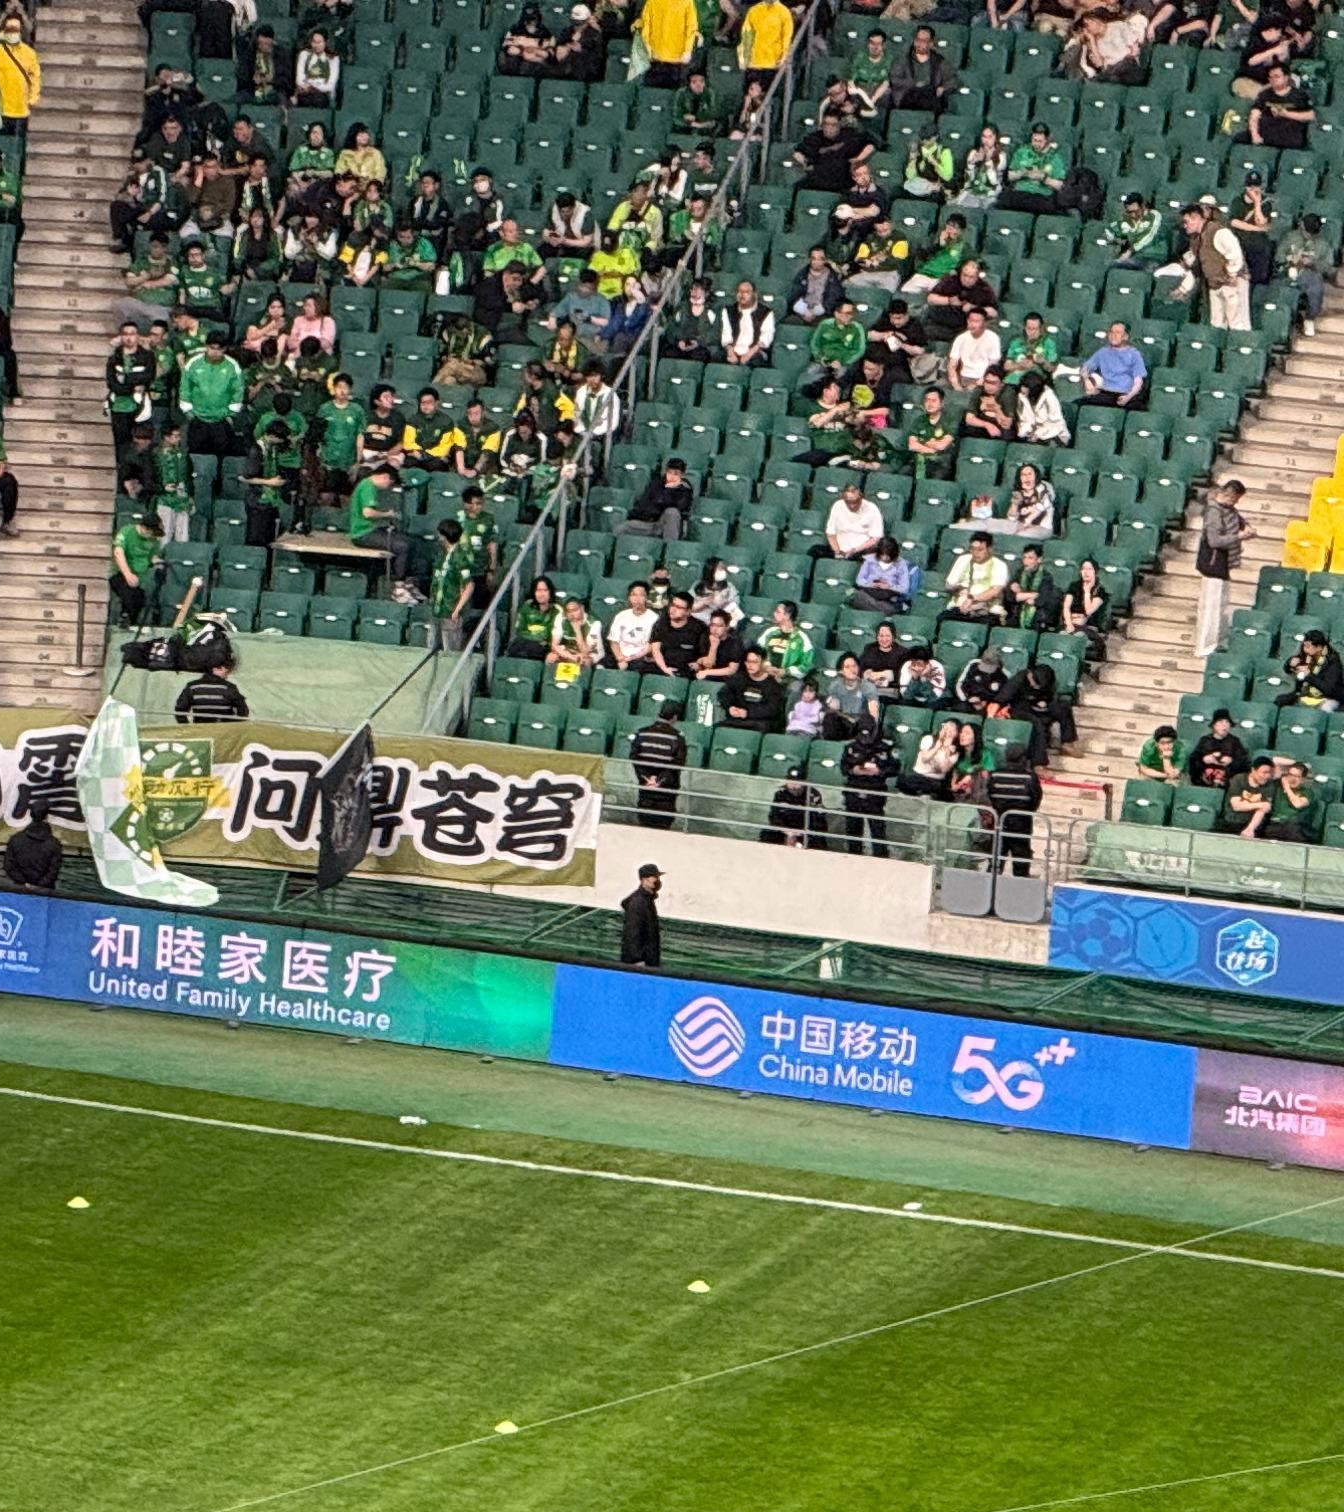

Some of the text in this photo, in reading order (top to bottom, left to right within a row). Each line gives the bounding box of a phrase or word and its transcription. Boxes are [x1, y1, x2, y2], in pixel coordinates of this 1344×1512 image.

[90, 916, 398, 1003] 和睦家医疗
[88, 969, 392, 1032] United Family Healthcare
[761, 1010, 918, 1067] 中国移动
[758, 1054, 914, 1097] China Mobile
